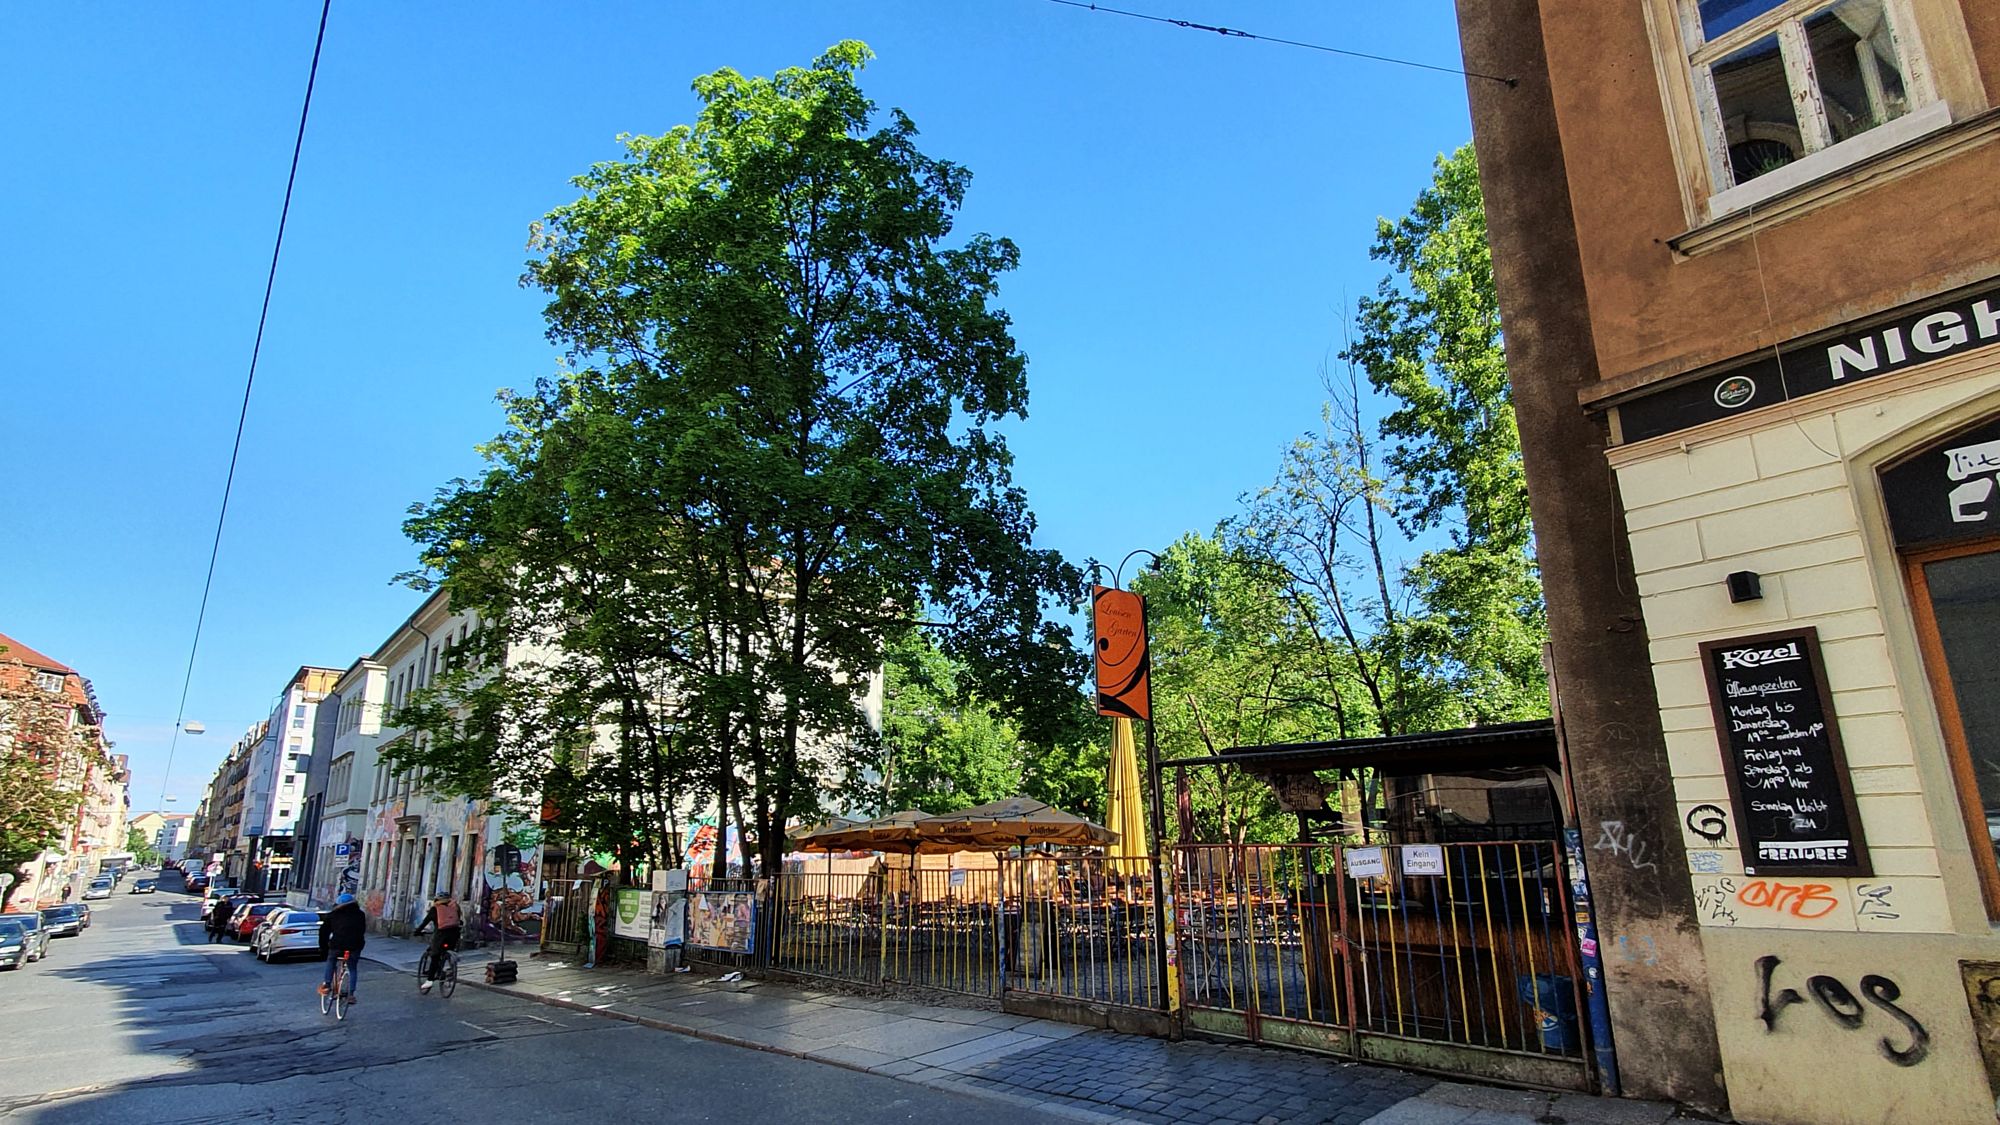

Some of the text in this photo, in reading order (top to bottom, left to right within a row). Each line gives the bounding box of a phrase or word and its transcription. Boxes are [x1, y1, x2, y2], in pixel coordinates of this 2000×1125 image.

[1721, 643, 1800, 669] Kozel
[1726, 676, 1798, 697] Öffnungszeiten
[1730, 702, 1795, 720] Montag bis
[1732, 720, 1789, 732] Donnerstag
[1744, 746, 1802, 765] Freitag und
[1744, 762, 1813, 777] Samstag ab
[1788, 776, 1810, 789] Uhr
[1751, 797, 1828, 818] Sonntag bleibt
[1412, 850, 1430, 859] Kein
[1759, 847, 1848, 861] CREATURES
[1350, 857, 1381, 867] AUSGANG
[1406, 859, 1438, 870] Eingang!
